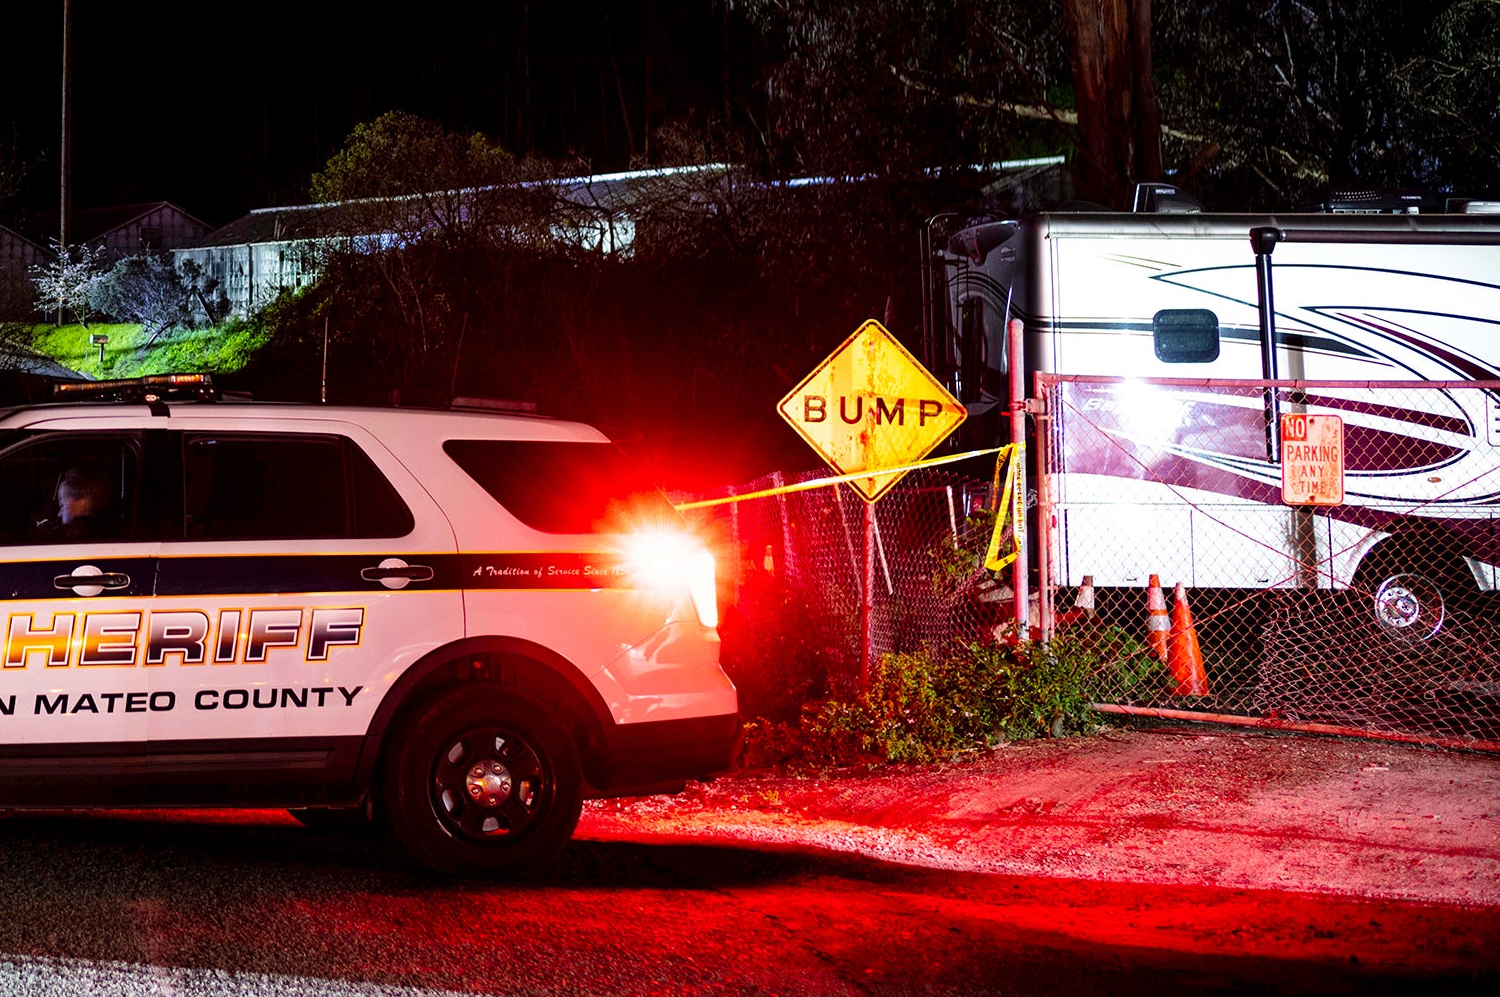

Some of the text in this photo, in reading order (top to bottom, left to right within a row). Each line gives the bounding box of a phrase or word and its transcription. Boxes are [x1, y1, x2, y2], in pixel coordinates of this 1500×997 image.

[804, 395, 943, 427] BUMP
[1285, 418, 1306, 438] NO
[1286, 445, 1338, 462] PARKING
[1301, 465, 1325, 478] ANY
[1300, 481, 1326, 494] TIME
[473, 566, 483, 577] A
[486, 566, 530, 577] Tradition
[534, 567, 543, 578] of
[548, 566, 580, 576] Service
[583, 565, 608, 576] Since
[34, 690, 177, 715] MATEO
[194, 685, 365, 710] COUNTY
